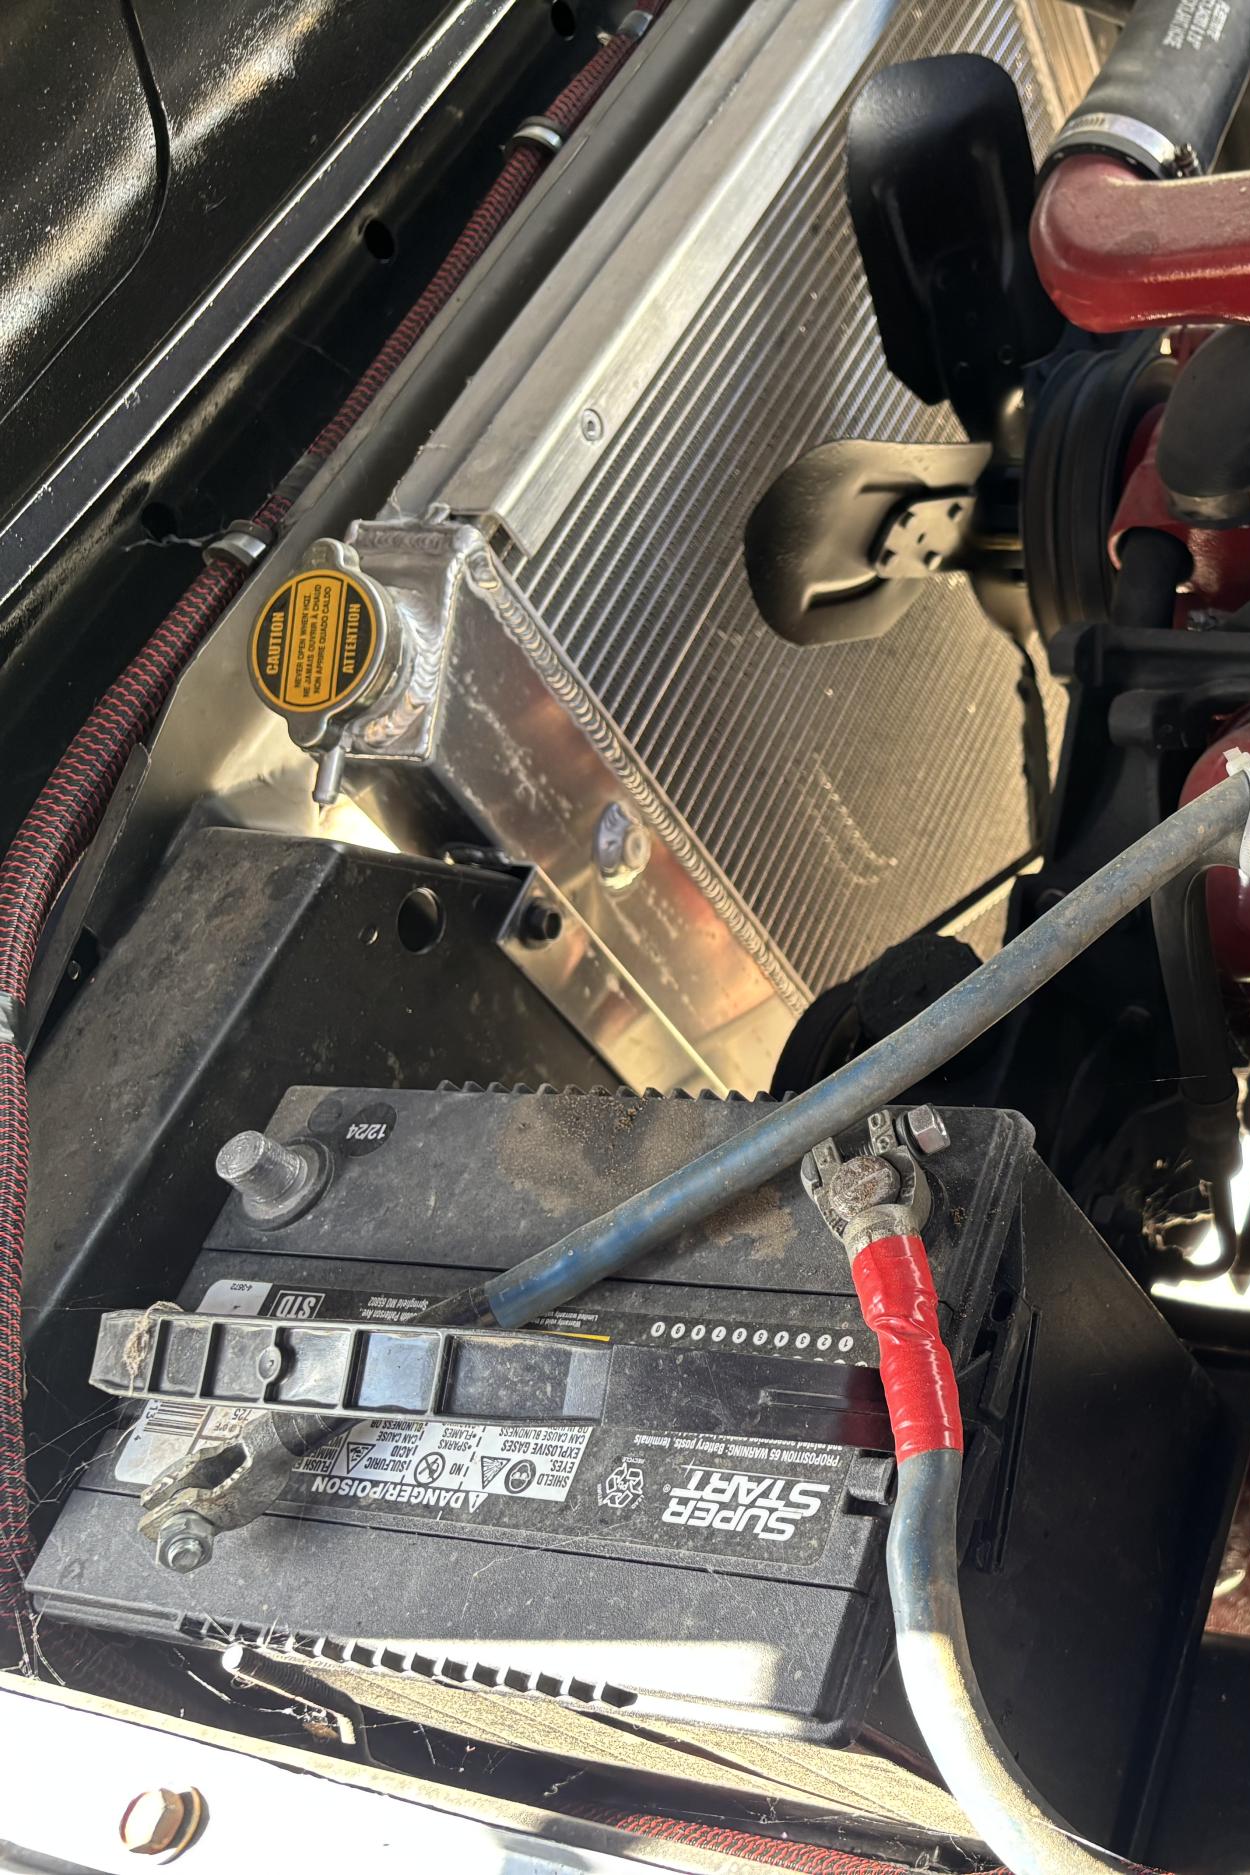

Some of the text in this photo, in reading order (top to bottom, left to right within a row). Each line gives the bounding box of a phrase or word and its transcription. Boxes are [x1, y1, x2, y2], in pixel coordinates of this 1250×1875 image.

[313, 585, 322, 612] CHAUD
[322, 586, 332, 614] CALDO
[301, 613, 309, 637] WHEN
[266, 612, 285, 675] CAUTION
[308, 622, 317, 652] OUVRIR
[343, 603, 361, 674] ATTENTION
[298, 638, 306, 660] OPEN
[316, 646, 326, 674] APRIRE
[295, 662, 304, 688] NEVER
[305, 655, 314, 685] JAMAIS
[303, 687, 311, 697] NE
[313, 676, 322, 693] NON
[346, 1123, 387, 1140] 12/24
[275, 1295, 316, 1318] STD
[396, 1298, 429, 1310] Springfield
[577, 1314, 598, 1322] Limited
[232, 1408, 252, 1420] 725
[382, 1420, 423, 1432] BLINDNESS
[376, 1431, 418, 1444] CAN CAUSE
[499, 1427, 586, 1444] CAN CAUSE BLINDNESS
[633, 1434, 671, 1448] terminals
[673, 1437, 696, 1450] posts,
[390, 1445, 413, 1458] ACID
[501, 1440, 581, 1459] EXPLOSIVE GASES
[695, 1439, 725, 1454] Battery
[726, 1444, 769, 1459] WARNING:
[769, 1449, 780, 1460] 65
[302, 1458, 332, 1473] FLUSH
[364, 1457, 407, 1472] SULFURIC
[781, 1450, 840, 1466] PROPOSITION
[449, 1463, 464, 1475] NO
[536, 1473, 569, 1488] SHIELD
[311, 1476, 466, 1508] DANGER/POISON
[670, 1470, 830, 1517] START
[662, 1498, 801, 1541] SUPER
